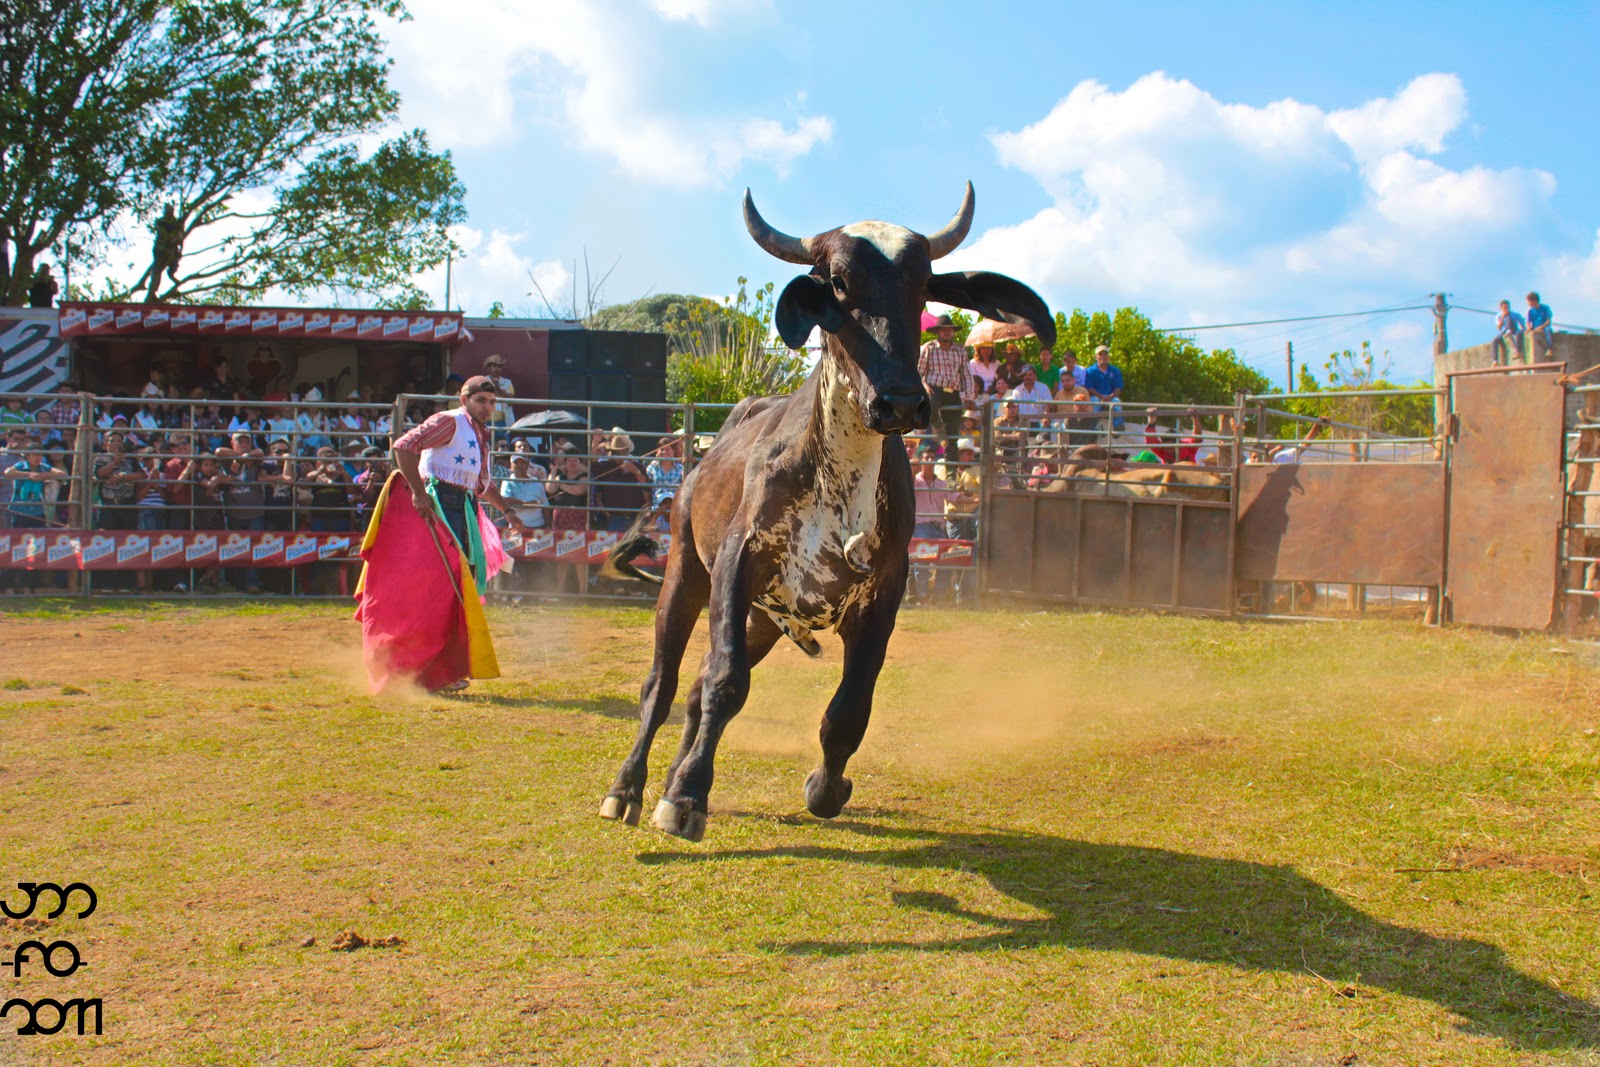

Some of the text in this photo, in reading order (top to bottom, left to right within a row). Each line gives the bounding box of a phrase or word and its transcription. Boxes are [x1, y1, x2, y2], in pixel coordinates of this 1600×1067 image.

[84, 545, 111, 559] Pilsener
[119, 544, 145, 560] Pilsener
[153, 543, 182, 560] Pilsener
[187, 543, 214, 560] Pilsener
[221, 543, 247, 559] Pilsener
[254, 543, 281, 559] Pilsener
[287, 543, 314, 559] Pilsener
[527, 540, 552, 553] Pilsener
[558, 540, 584, 554] Pilsener
